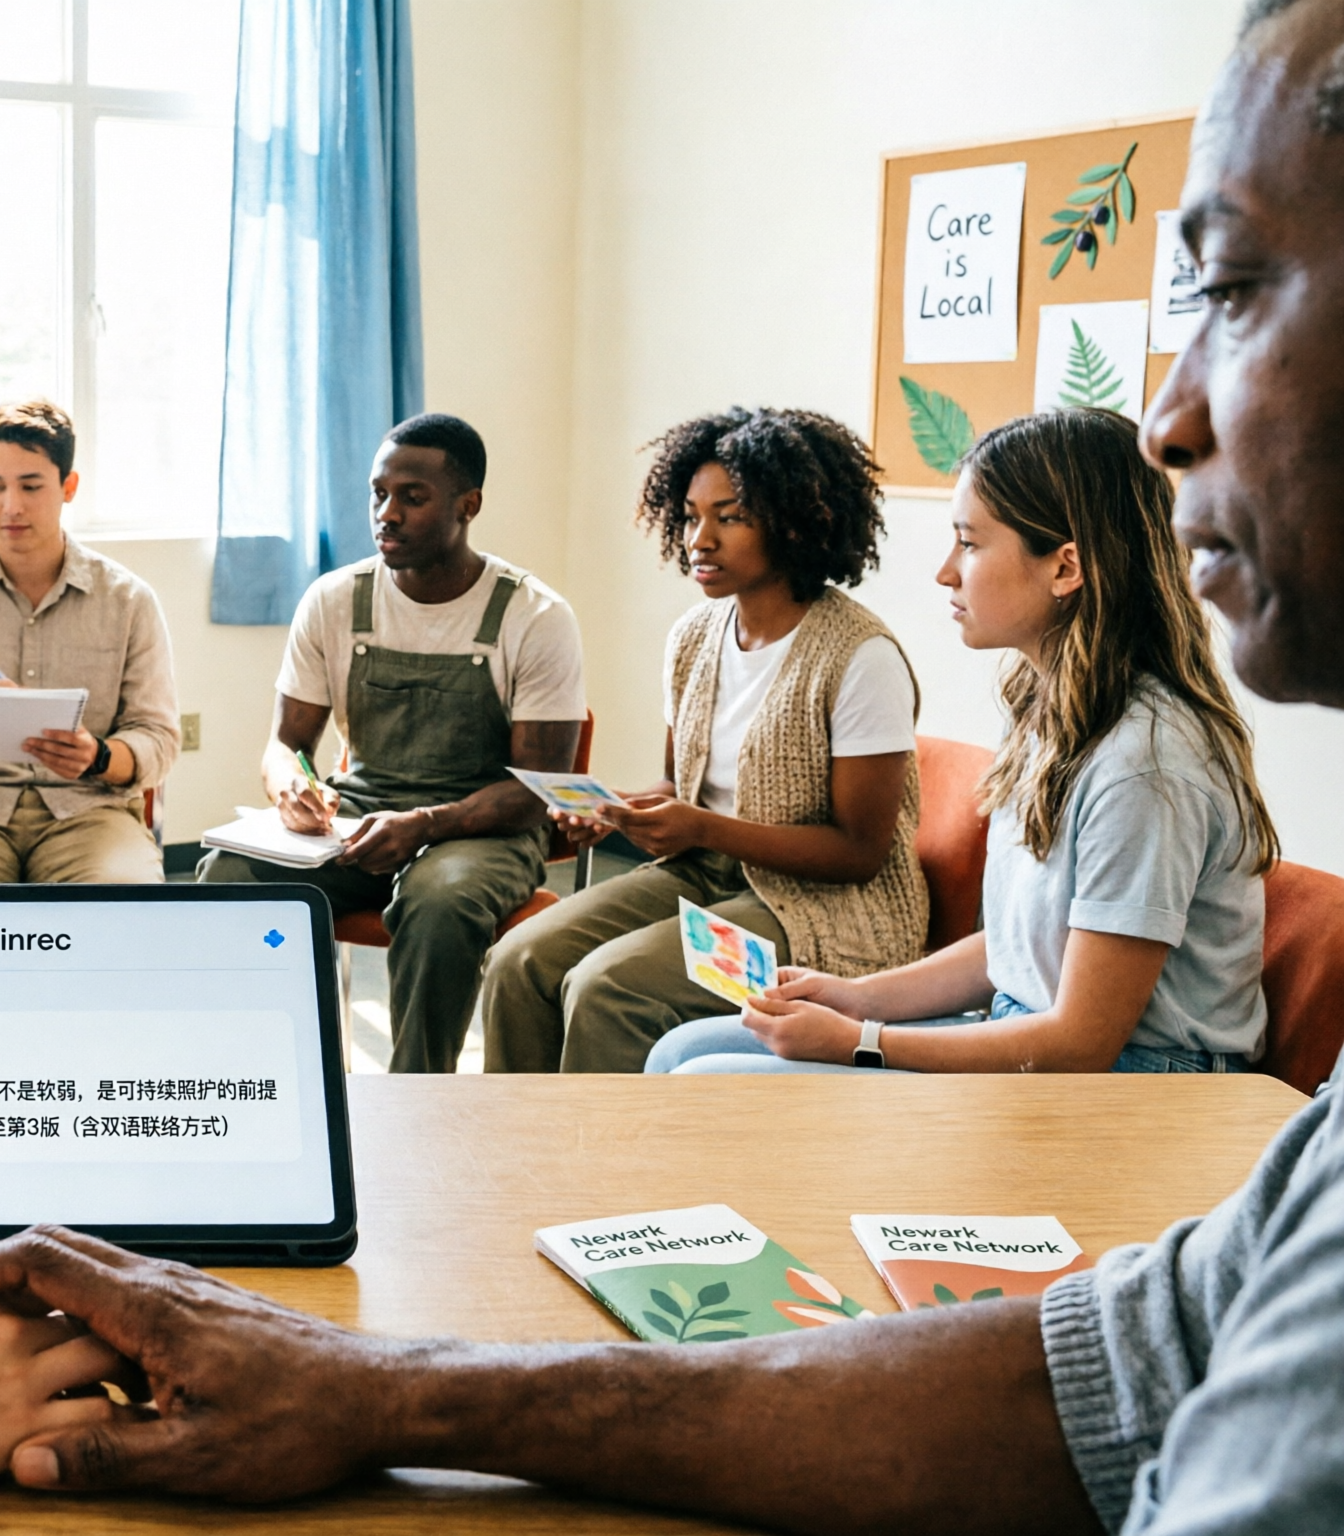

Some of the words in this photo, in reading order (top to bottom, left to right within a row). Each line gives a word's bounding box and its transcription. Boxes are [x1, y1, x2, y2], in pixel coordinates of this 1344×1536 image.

[926, 203, 994, 242] Care
[944, 249, 968, 278] is
[919, 276, 993, 320] Local
[570, 1225, 667, 1249] Newark
[584, 1244, 644, 1262] Care
[645, 1230, 751, 1252] Network
[880, 1226, 980, 1239] Newark
[888, 1240, 948, 1252] Care
[953, 1241, 1063, 1254] Network
